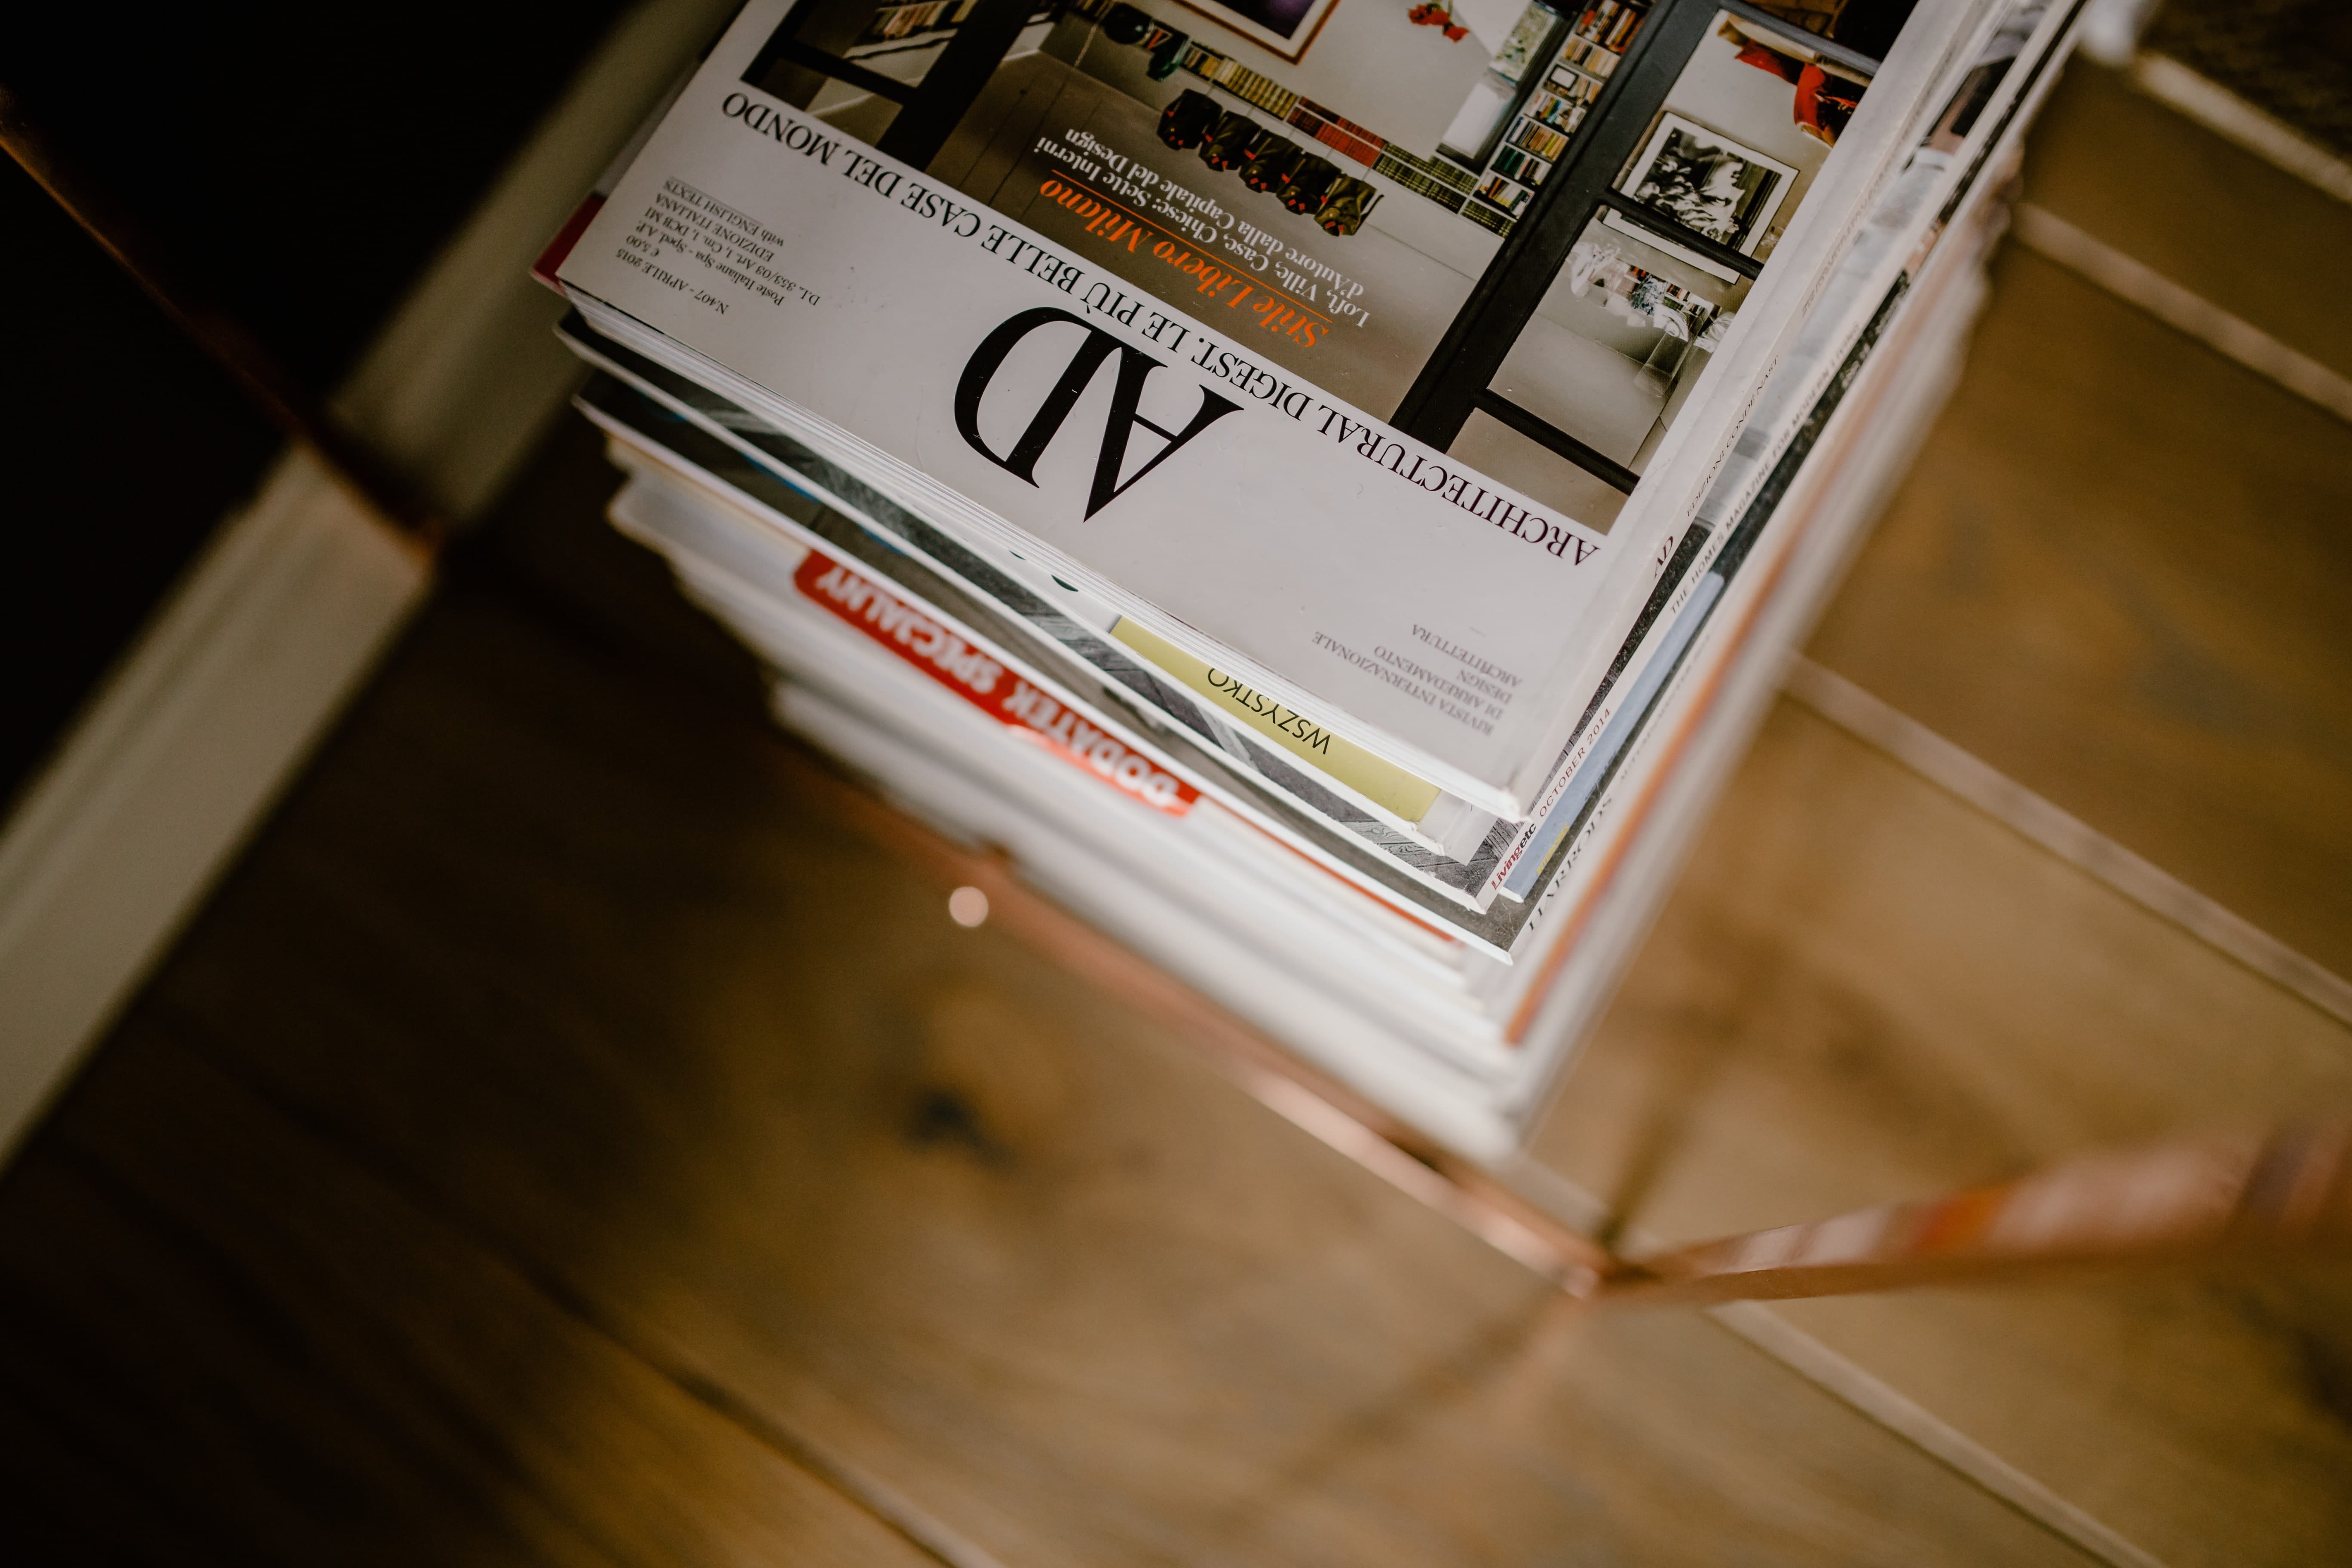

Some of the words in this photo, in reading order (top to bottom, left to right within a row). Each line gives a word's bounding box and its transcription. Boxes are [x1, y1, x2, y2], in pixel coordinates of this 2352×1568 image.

[721, 92, 840, 166] MONDO
[1033, 136, 1102, 181] Interni
[1064, 128, 1129, 170] Design
[662, 179, 703, 207] TEXTS
[842, 149, 903, 199] DEL
[1102, 172, 1152, 207] Sette
[1128, 162, 1160, 185] del
[644, 206, 664, 222] MI
[655, 192, 713, 230] ITALIANA
[702, 199, 760, 236] ENGLISH
[900, 182, 981, 238] CASE
[1039, 179, 1154, 252] Milano
[1151, 197, 1218, 243] Chiese:
[1159, 179, 1235, 230] Capitale
[625, 234, 652, 253] 5,00
[634, 220, 658, 237] A.P.
[658, 233, 688, 254] Sped.
[662, 215, 690, 236] DCB
[692, 228, 700, 242] 1,
[703, 236, 723, 254] Cm.
[714, 223, 775, 263] EDIZIONE
[760, 228, 784, 247] with
[1237, 220, 1284, 254] dalla
[615, 248, 644, 268] 2015
[694, 250, 716, 269] Spa
[725, 246, 733, 259] 1,
[735, 253, 756, 270] Art.
[980, 224, 1085, 295] BELLE
[1222, 233, 1269, 272] Case,
[640, 261, 689, 291] APRILE
[714, 262, 756, 291] Italiane
[754, 265, 797, 292] 353/03
[1152, 240, 1256, 308] Libero
[1274, 261, 1317, 302] Ville,
[1284, 248, 1364, 299] d'Autore
[693, 289, 730, 315] N.407
[755, 284, 786, 307] Poste
[798, 285, 822, 307] D.L.
[1078, 282, 1145, 328] PIÙ
[1326, 289, 1370, 328] Loft,
[1140, 311, 1191, 353] LE
[1252, 294, 1330, 348] Stile
[1189, 337, 1314, 422] DIGEST.
[953, 306, 1244, 522] AD
[1316, 404, 1601, 566] ARCHITECTURAL
[1654, 536, 1673, 580] AD
[1687, 450, 1724, 517] EDIZIONI
[1757, 355, 1778, 395] NAST
[815, 565, 1004, 694] SPECJALNY
[1539, 747, 1586, 817] OCTOBER
[1587, 707, 1611, 745] 2014
[1671, 588, 1689, 615] THE
[1691, 533, 1725, 583] HOMES
[1725, 459, 1770, 530] MAGAZINE
[1772, 429, 1791, 458] FOR
[1311, 630, 1437, 706] INTERNAZIONALE
[1411, 623, 1523, 688] ARCHITETTURA
[1373, 645, 1480, 708] ARREDAMENTO
[1456, 669, 1513, 704] DESIGN
[1207, 668, 1331, 755] WSZYSTKO
[1439, 698, 1494, 736] RIVISTA
[1484, 704, 1504, 720] DI
[1002, 681, 1179, 805] DODATEK
